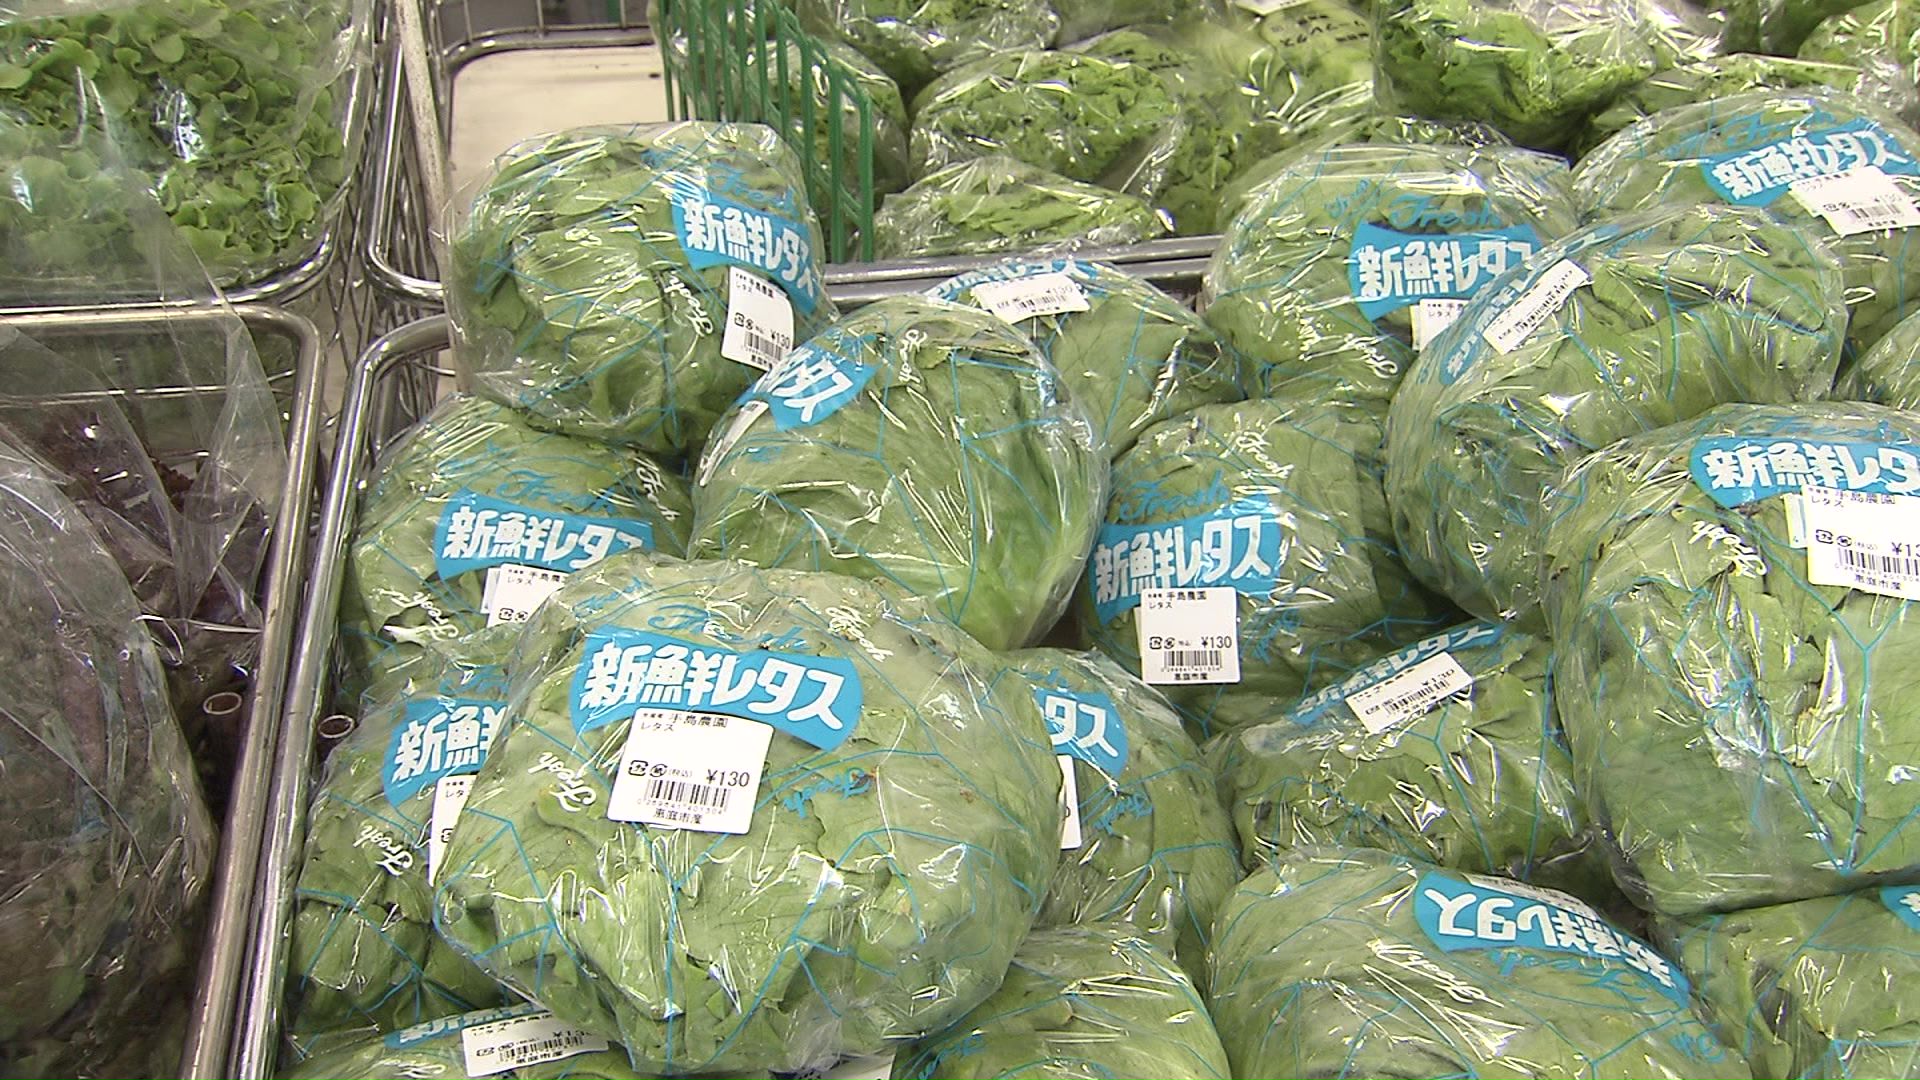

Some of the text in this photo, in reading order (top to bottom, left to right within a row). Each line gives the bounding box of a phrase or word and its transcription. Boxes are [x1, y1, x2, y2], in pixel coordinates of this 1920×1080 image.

[1711, 130, 1909, 200] 新鮮レタス
[683, 198, 814, 298] 新鮮レタス
[1119, 469, 1229, 521] Fresh
[1811, 496, 1844, 508] レタス
[1094, 515, 1271, 604] 新鮮レタス
[1200, 635, 1232, 649] ¥130
[579, 644, 844, 731] 新鮮レタス
[640, 722, 675, 732] レタス
[528, 752, 597, 812] Fresh
[706, 769, 750, 787] ¥130
[353, 825, 414, 876] Fresh
[1424, 888, 1678, 988] 新鮮レタス
